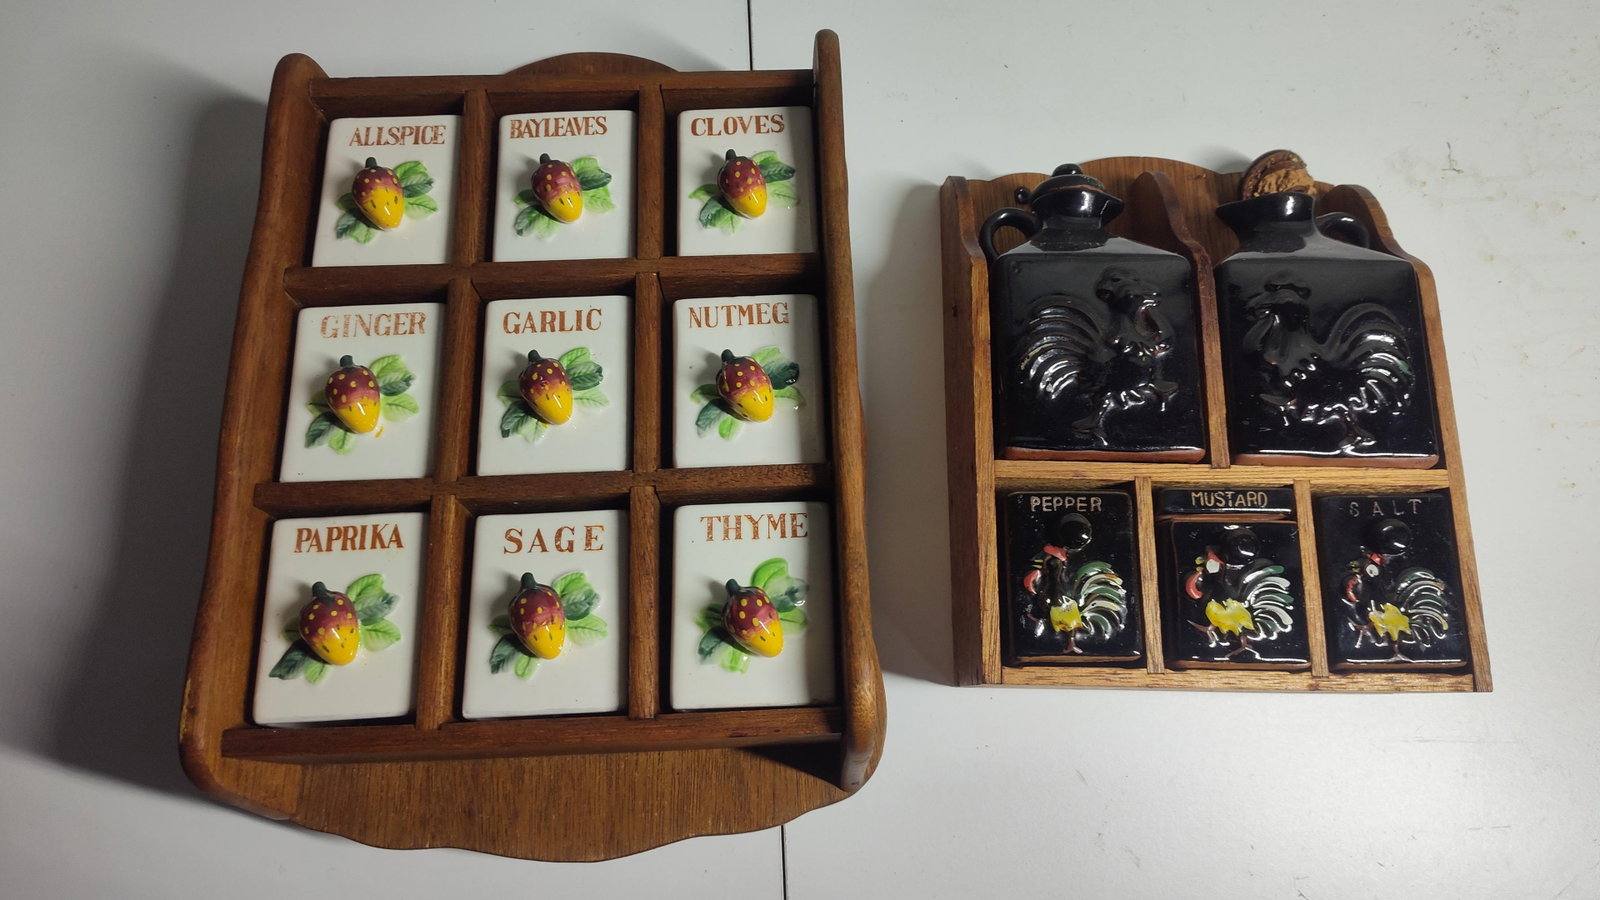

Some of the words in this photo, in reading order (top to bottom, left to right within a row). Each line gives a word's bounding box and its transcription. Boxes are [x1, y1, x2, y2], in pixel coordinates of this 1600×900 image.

[349, 124, 448, 147] ALLSPICE
[509, 116, 608, 139] BAYLEAVES
[690, 114, 785, 137] CLOVES
[320, 312, 427, 338] GINGER
[502, 307, 603, 334] GARLIC
[688, 301, 790, 328] NUTMEG
[1030, 495, 1103, 512] PEPPER
[1191, 491, 1269, 508] MUSTARD
[1349, 499, 1422, 517] SALT
[293, 523, 405, 553] PAPRIKA
[700, 513, 808, 542] THYME
[503, 525, 605, 555] SAGE
